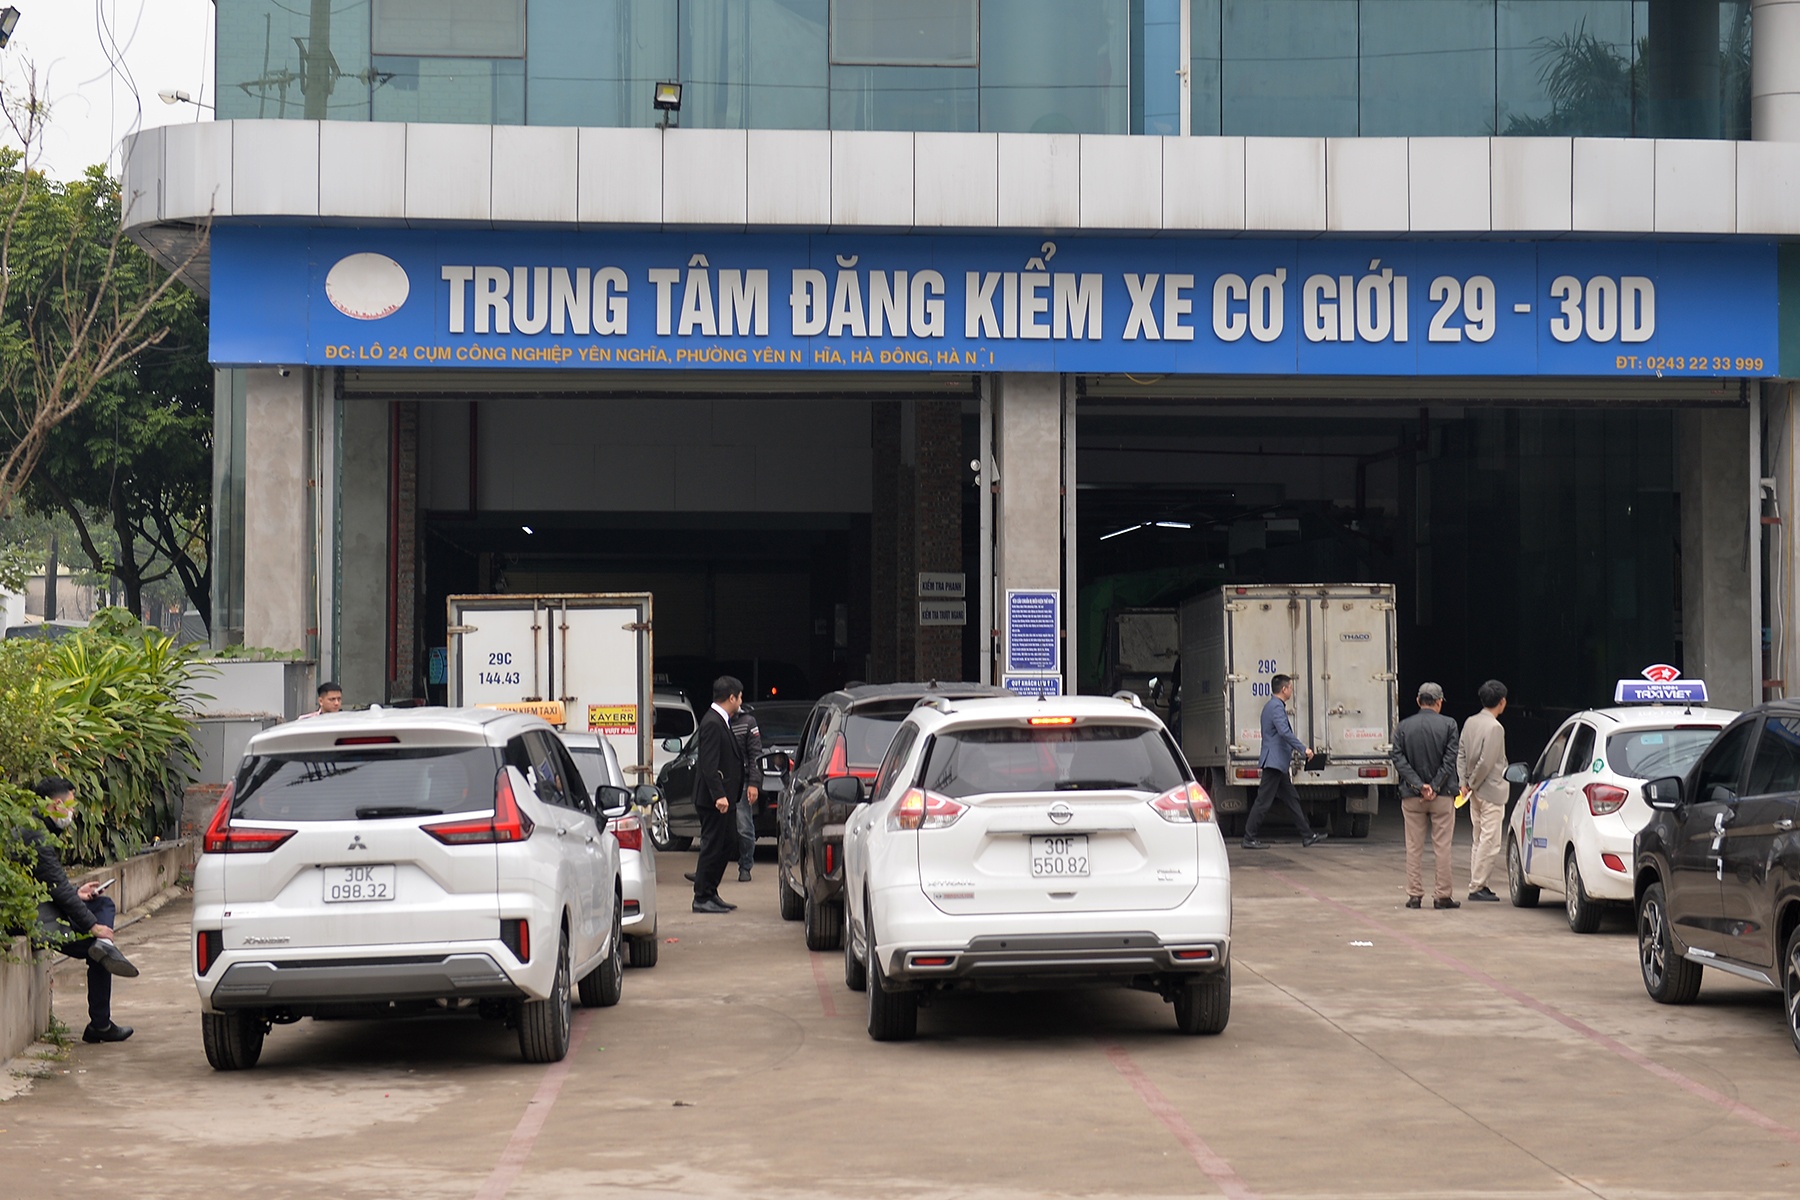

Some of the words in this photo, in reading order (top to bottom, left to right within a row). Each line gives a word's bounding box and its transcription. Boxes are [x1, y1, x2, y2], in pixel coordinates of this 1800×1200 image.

[441, 265, 629, 336] TRUNG
[648, 253, 769, 337] TÂM
[790, 254, 946, 339] ĐĂNG
[965, 241, 1103, 340] KIỂM
[1122, 273, 1195, 341] XE
[1212, 267, 1287, 343] CƠ
[1302, 258, 1408, 343] GIỚI
[1428, 275, 1497, 344] 29
[1513, 302, 1531, 314] -
[1550, 275, 1656, 344] 30D
[325, 345, 356, 360] ĐC:
[359, 341, 383, 360] LÔ
[388, 346, 408, 360] 24
[413, 346, 452, 363] CỤM
[456, 342, 507, 361] CÔNG
[511, 345, 573, 364] NGHIỆP
[578, 344, 611, 362] YÊN
[616, 346, 672, 364] NGHĨA,
[676, 345, 747, 363] PHƯỜNG
[752, 346, 785, 363] YÊN
[851, 346, 875, 364] HÀ
[880, 346, 932, 366] ĐÔNG,
[937, 347, 960, 365] HÀ
[1616, 356, 1642, 369] ĐT:
[1647, 356, 1685, 370] 0243
[1689, 357, 1708, 370] 22
[1712, 357, 1731, 370] 33
[1735, 357, 1764, 371] 999
[489, 652, 512, 665] 29C
[1258, 659, 1277, 674] 29C
[479, 671, 520, 685] 144.43
[1252, 682, 1273, 697] 900.
[539, 705, 558, 715] TAXI
[1045, 838, 1074, 855] 30F
[1034, 857, 1088, 874] 550.82
[344, 867, 374, 882] 30K
[331, 883, 387, 899] 098.32
